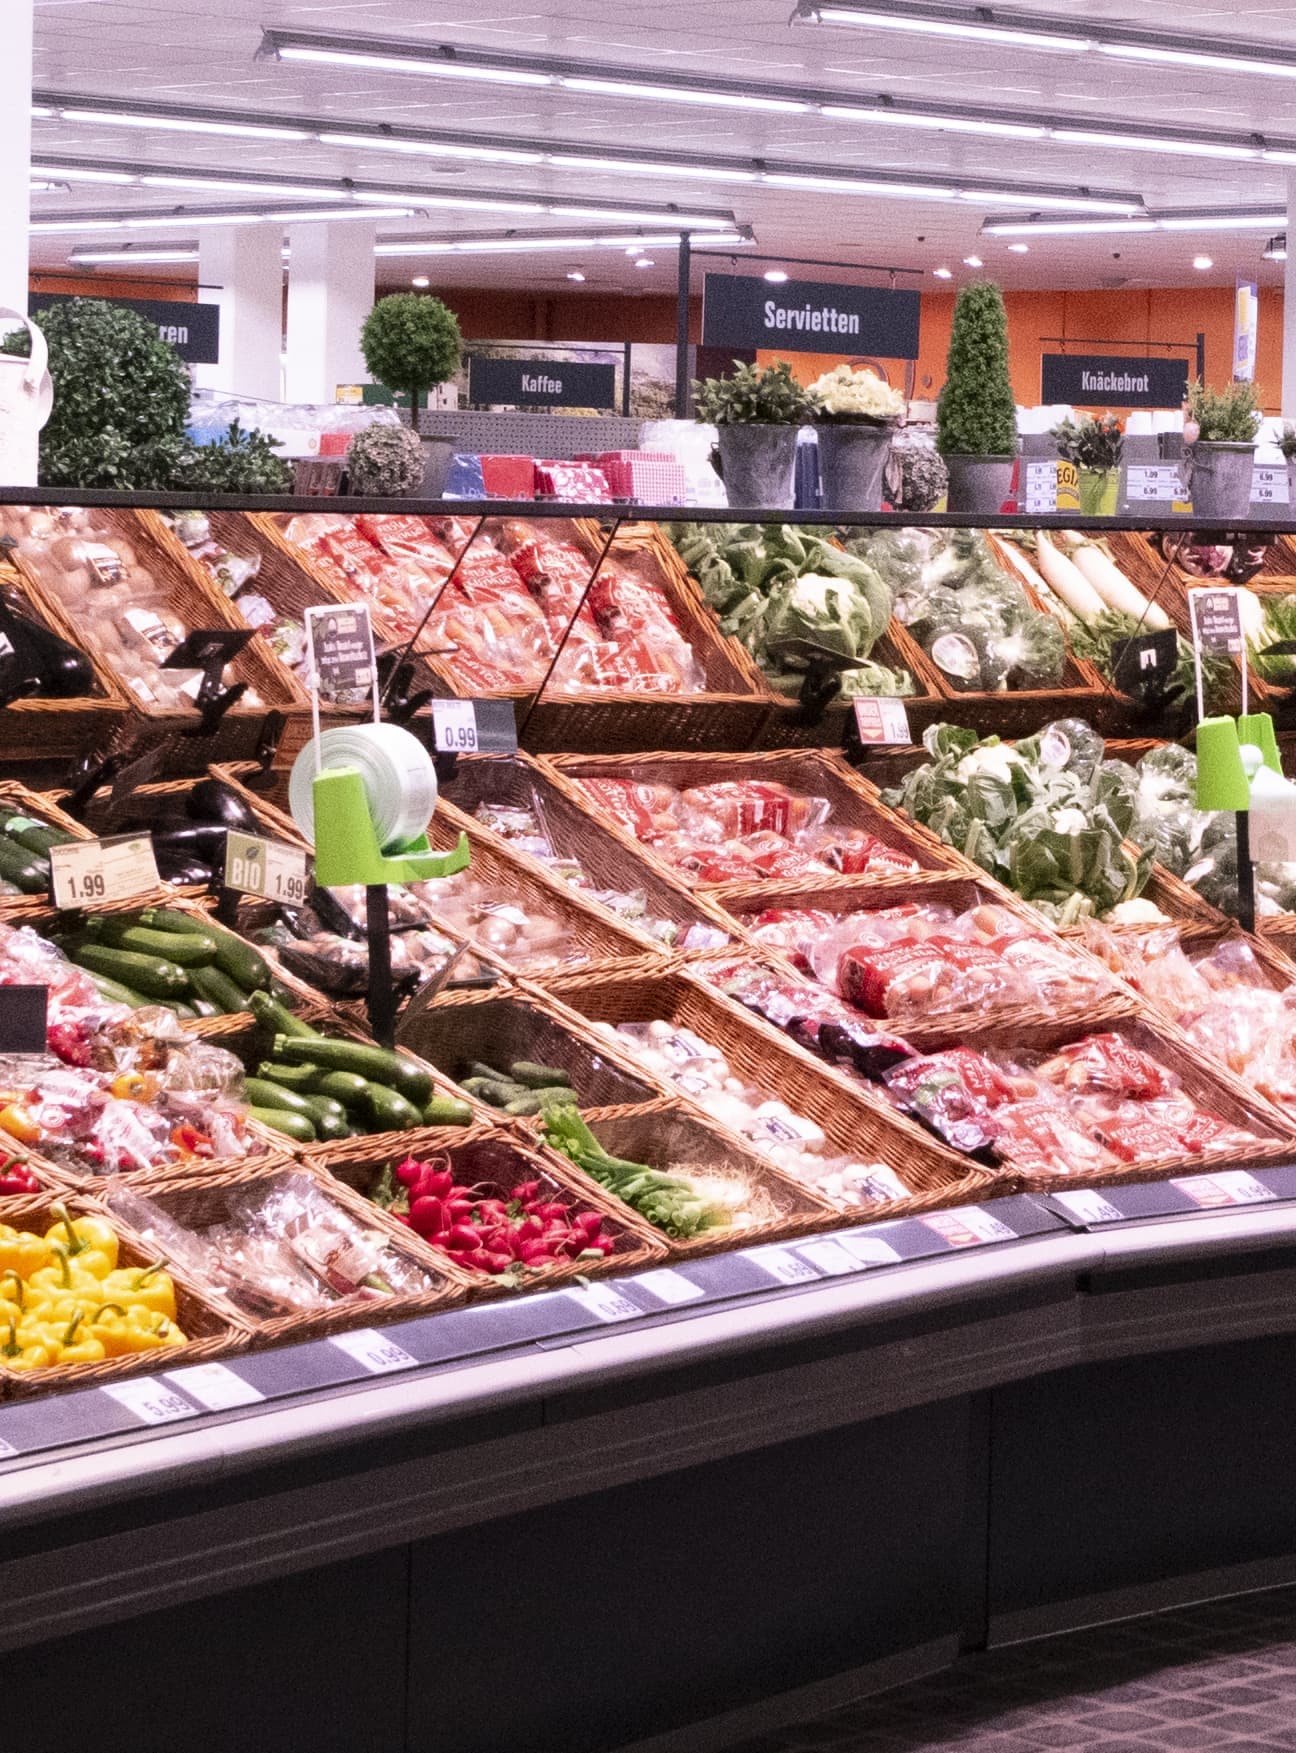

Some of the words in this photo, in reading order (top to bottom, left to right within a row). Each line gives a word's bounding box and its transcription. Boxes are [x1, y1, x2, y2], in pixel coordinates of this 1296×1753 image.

[764, 300, 860, 335] Servietten
[522, 374, 563, 394] Kaffee
[1082, 370, 1149, 392] Knäckebrot
[445, 726, 476, 747] 0.99
[232, 857, 261, 890] BIO
[68, 874, 105, 898] 1.99
[276, 874, 303, 900] 1.99
[1083, 1205, 1121, 1220] 1.49
[366, 1346, 409, 1365] 0.99
[143, 1396, 190, 1417] 5.99
